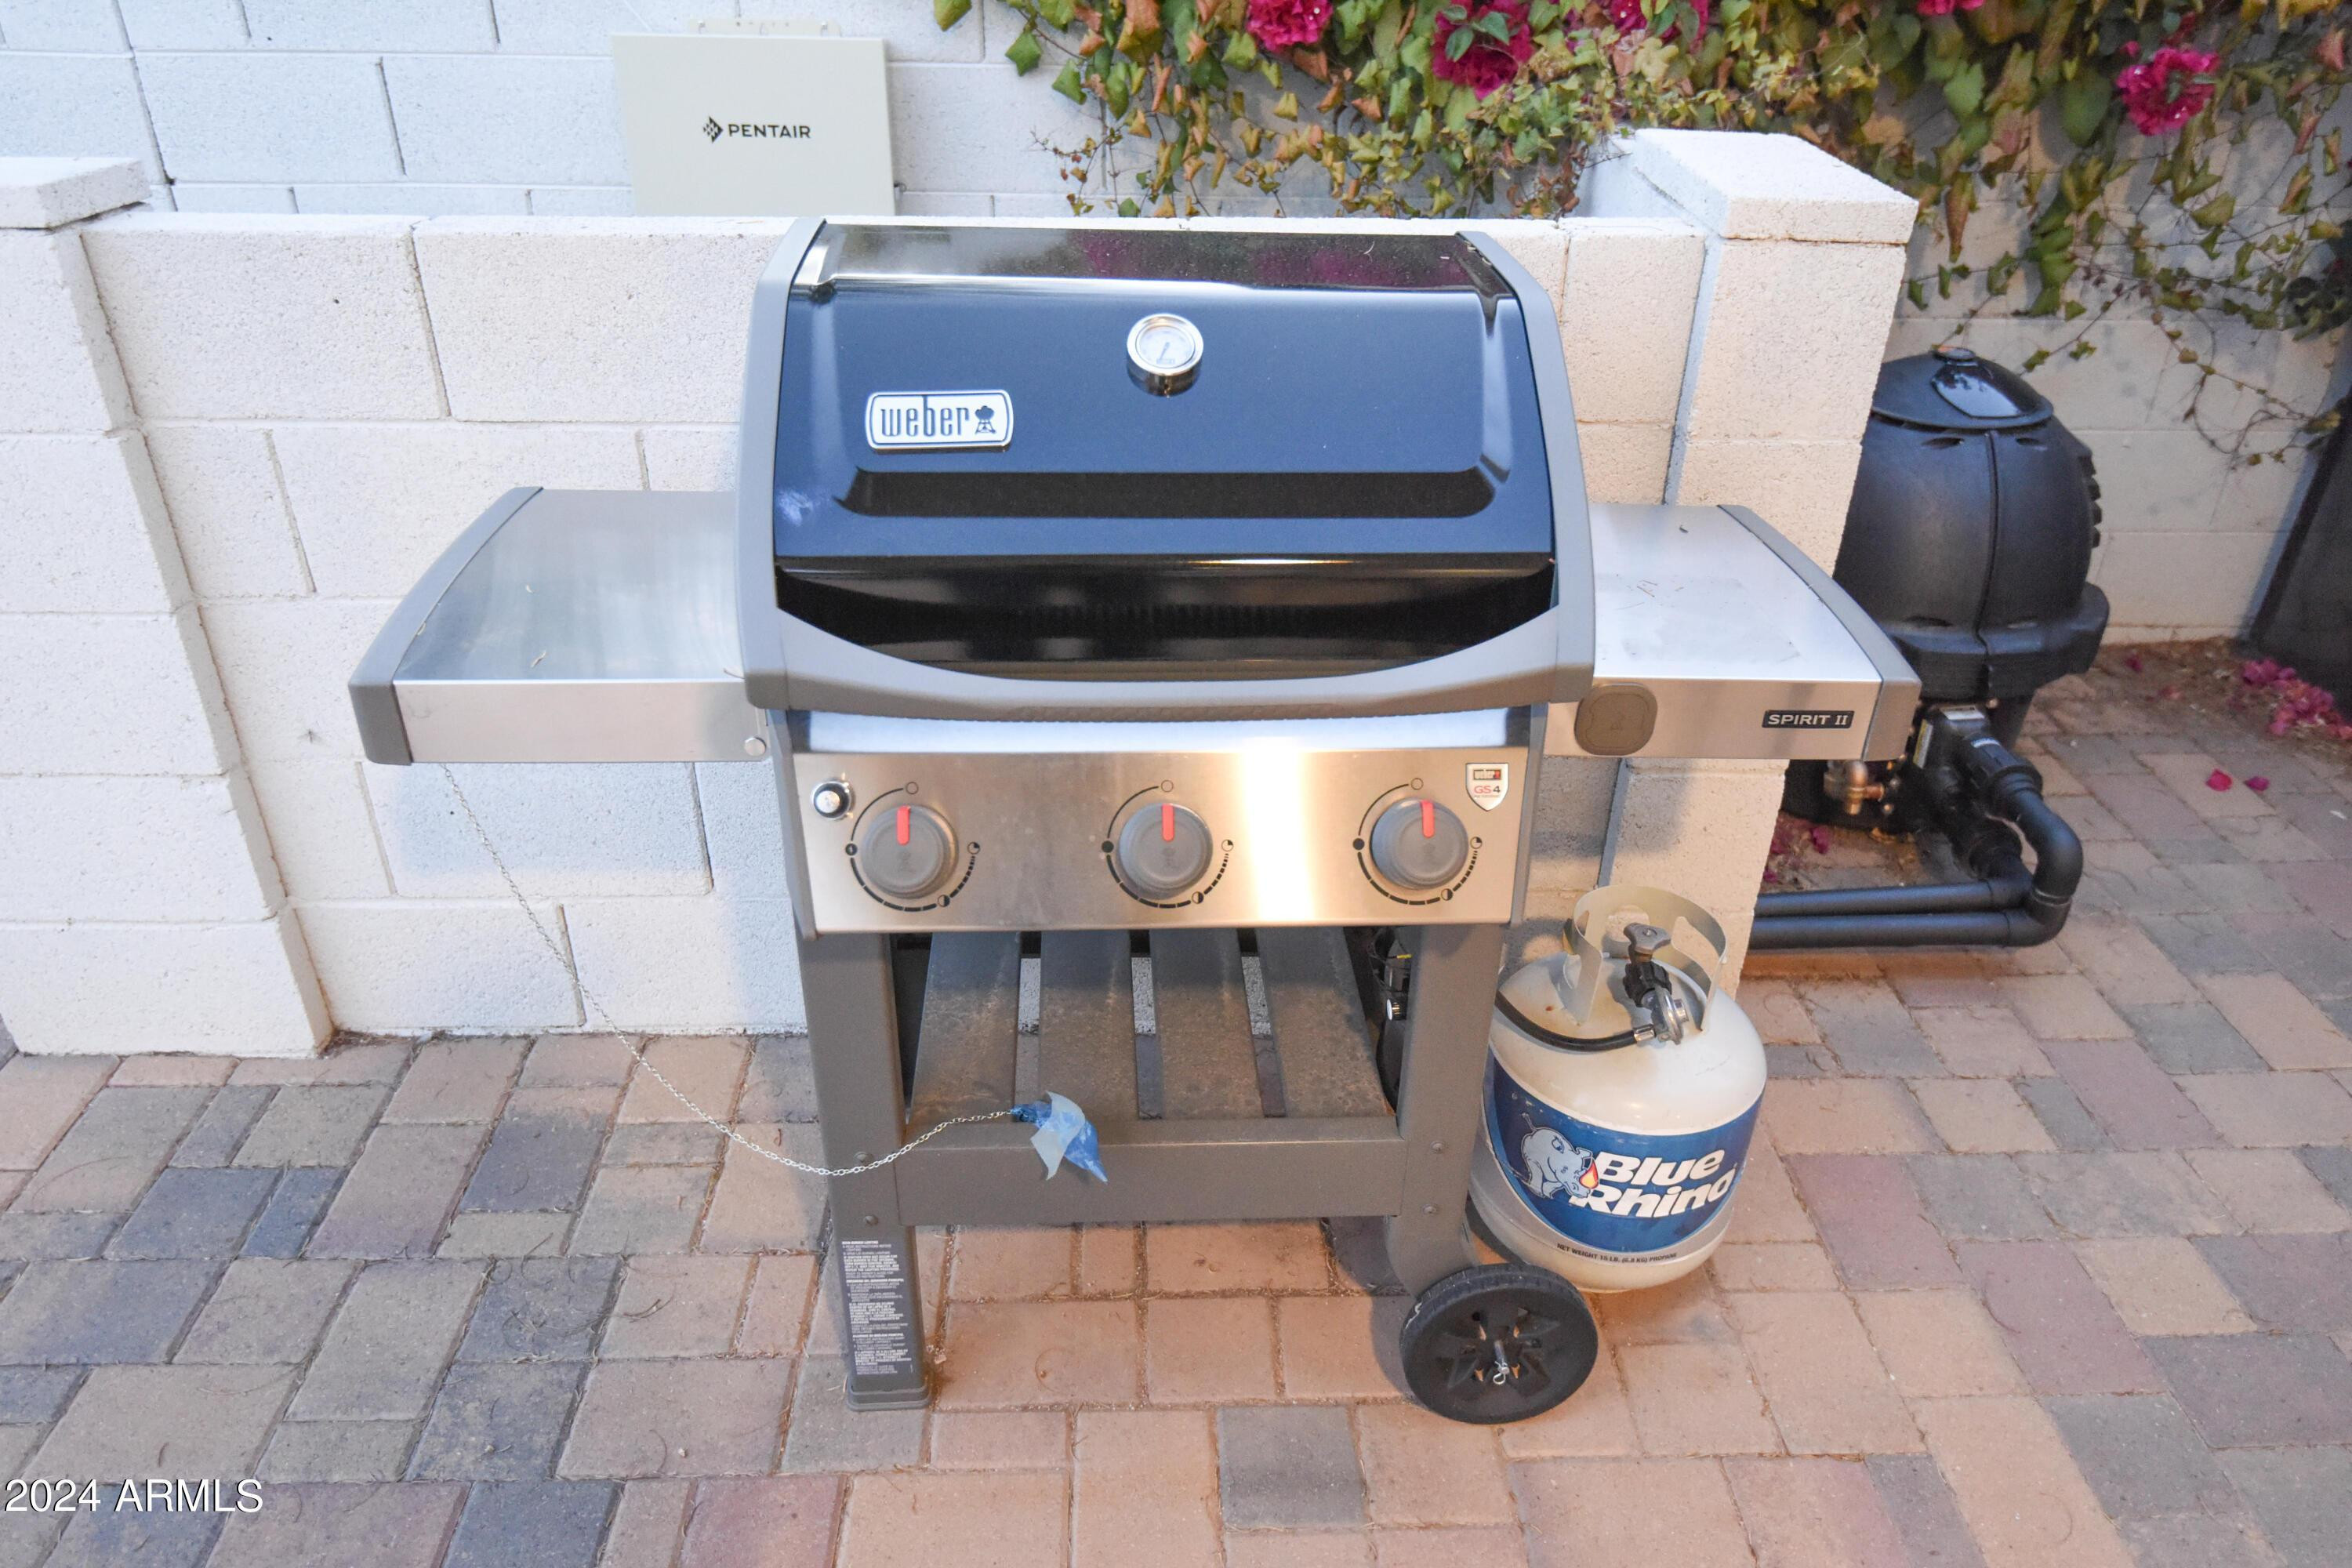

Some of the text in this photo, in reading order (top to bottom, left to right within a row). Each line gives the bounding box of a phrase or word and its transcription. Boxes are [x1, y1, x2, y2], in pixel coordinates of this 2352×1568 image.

[728, 123, 811, 139] PENTAIR
[880, 394, 970, 437] weber
[1768, 714, 1849, 725] SPIRIT II
[1595, 1149, 1726, 1187] Blue
[1569, 1167, 1736, 1218] Rhino
[1556, 1243, 1570, 1252] NET
[1572, 1248, 1598, 1261] WEIGHT
[1649, 1252, 1678, 1262] PROPANE
